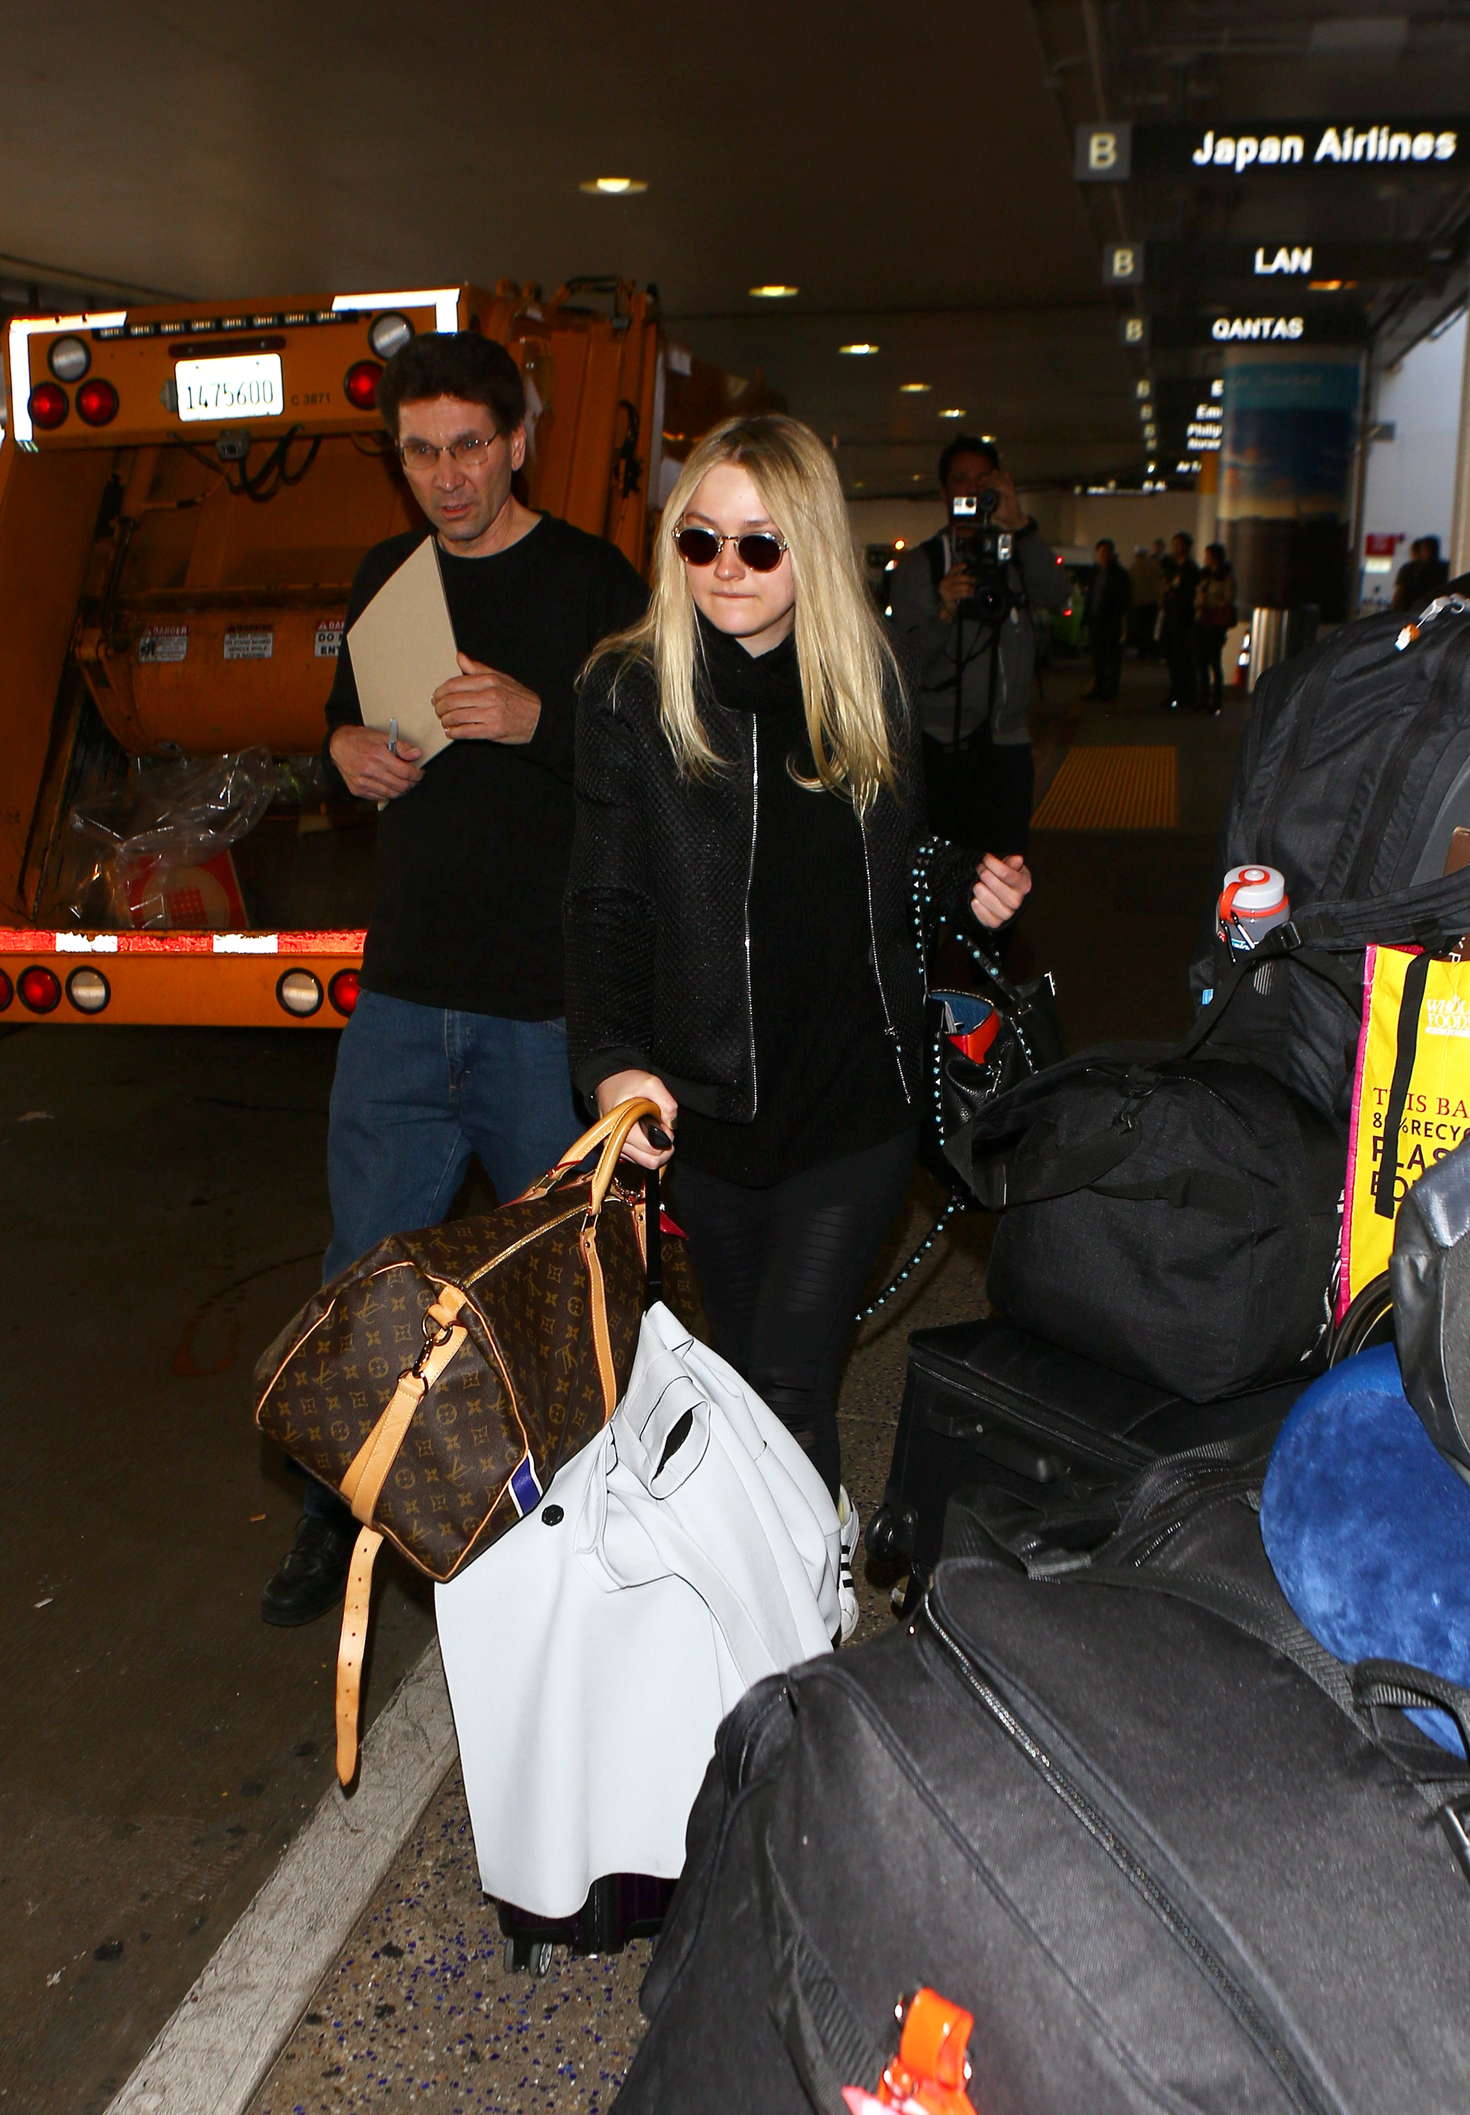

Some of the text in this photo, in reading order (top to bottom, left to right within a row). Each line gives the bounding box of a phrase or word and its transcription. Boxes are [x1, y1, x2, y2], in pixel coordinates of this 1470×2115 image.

[1088, 132, 1117, 170] B
[1192, 126, 1457, 173] Japan Airlines
[1113, 249, 1134, 277] B
[1254, 247, 1313, 274] LAN
[1126, 319, 1143, 342] B
[1212, 317, 1304, 340] QANTAS
[186, 380, 274, 410] 1475600
[320, 645, 341, 656] EN
[1373, 1087, 1427, 1113] TIS
